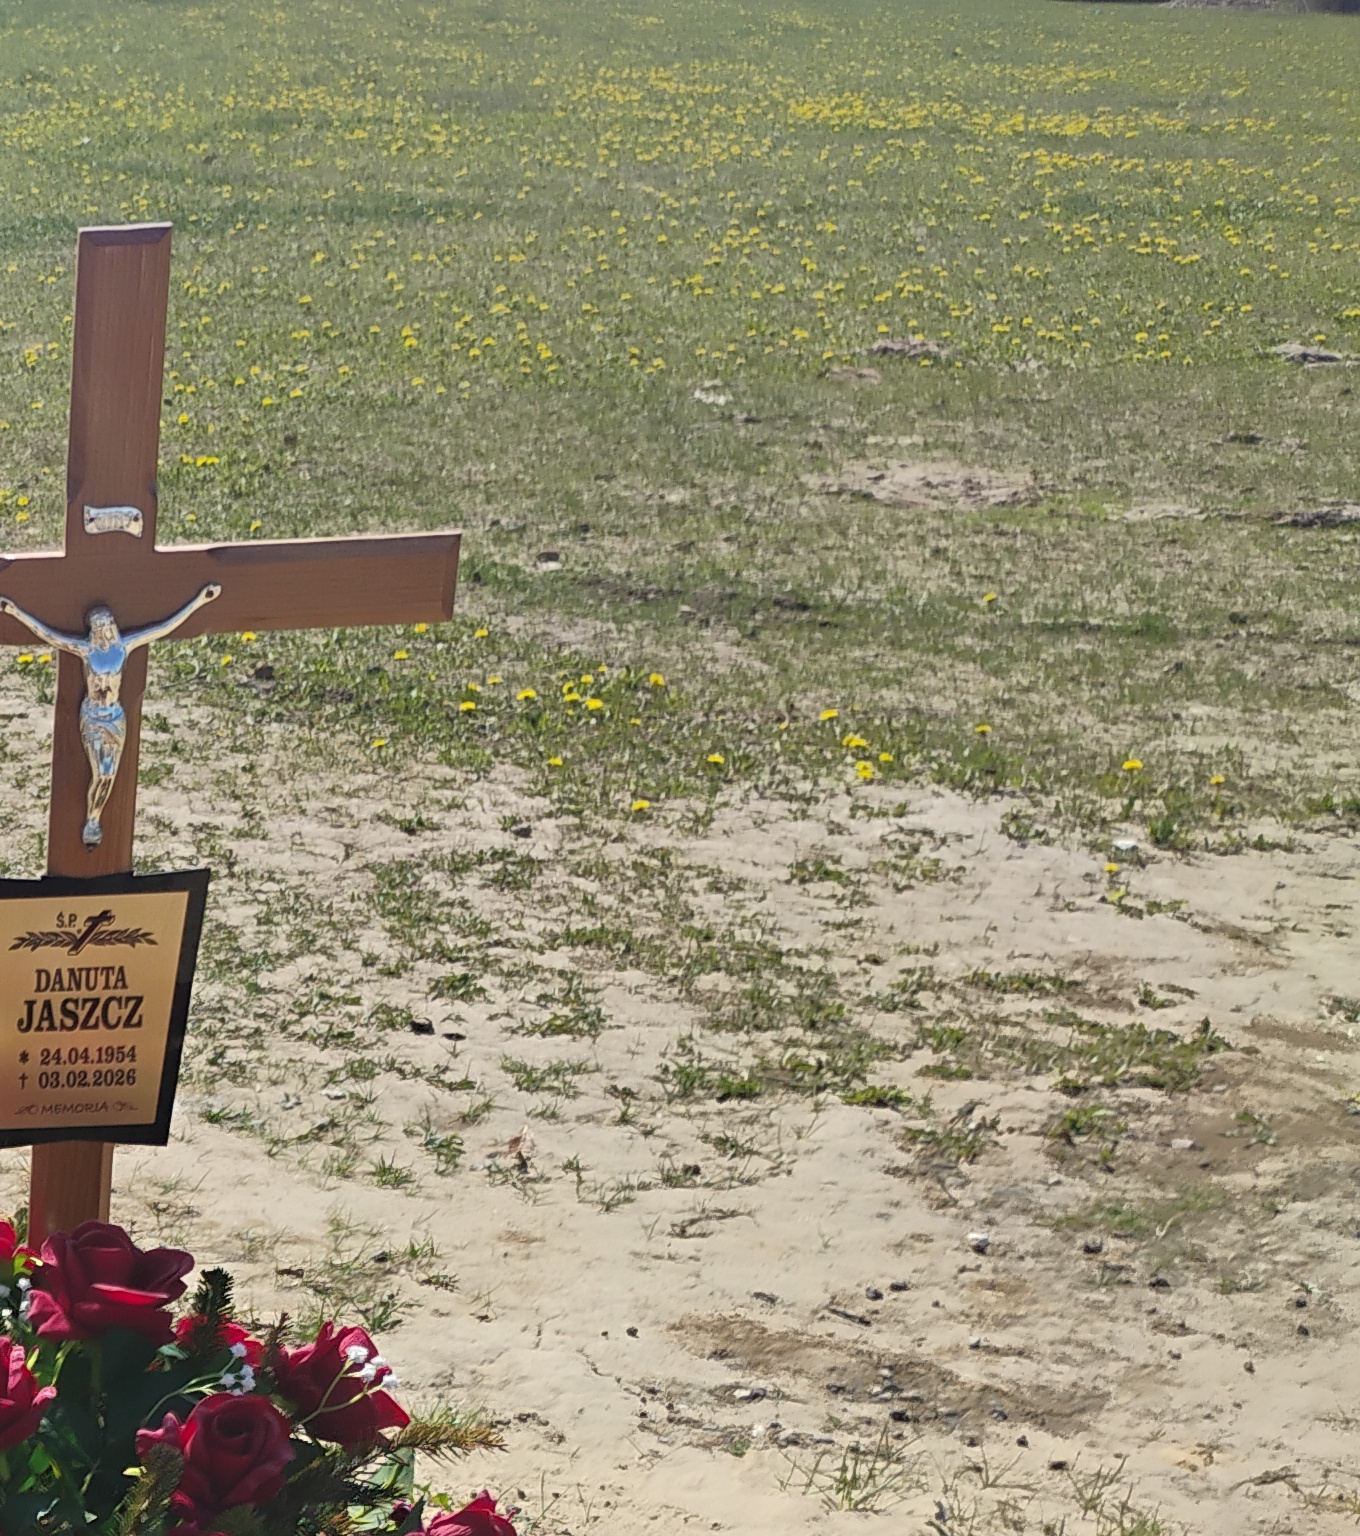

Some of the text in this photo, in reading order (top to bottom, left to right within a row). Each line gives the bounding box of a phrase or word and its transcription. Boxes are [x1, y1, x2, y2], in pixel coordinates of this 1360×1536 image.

[34, 965, 129, 993] DANUTA
[16, 995, 144, 1035] JASZCZ
[39, 1044, 137, 1067] 24.04.1954
[38, 1067, 137, 1090] 03.02.2026
